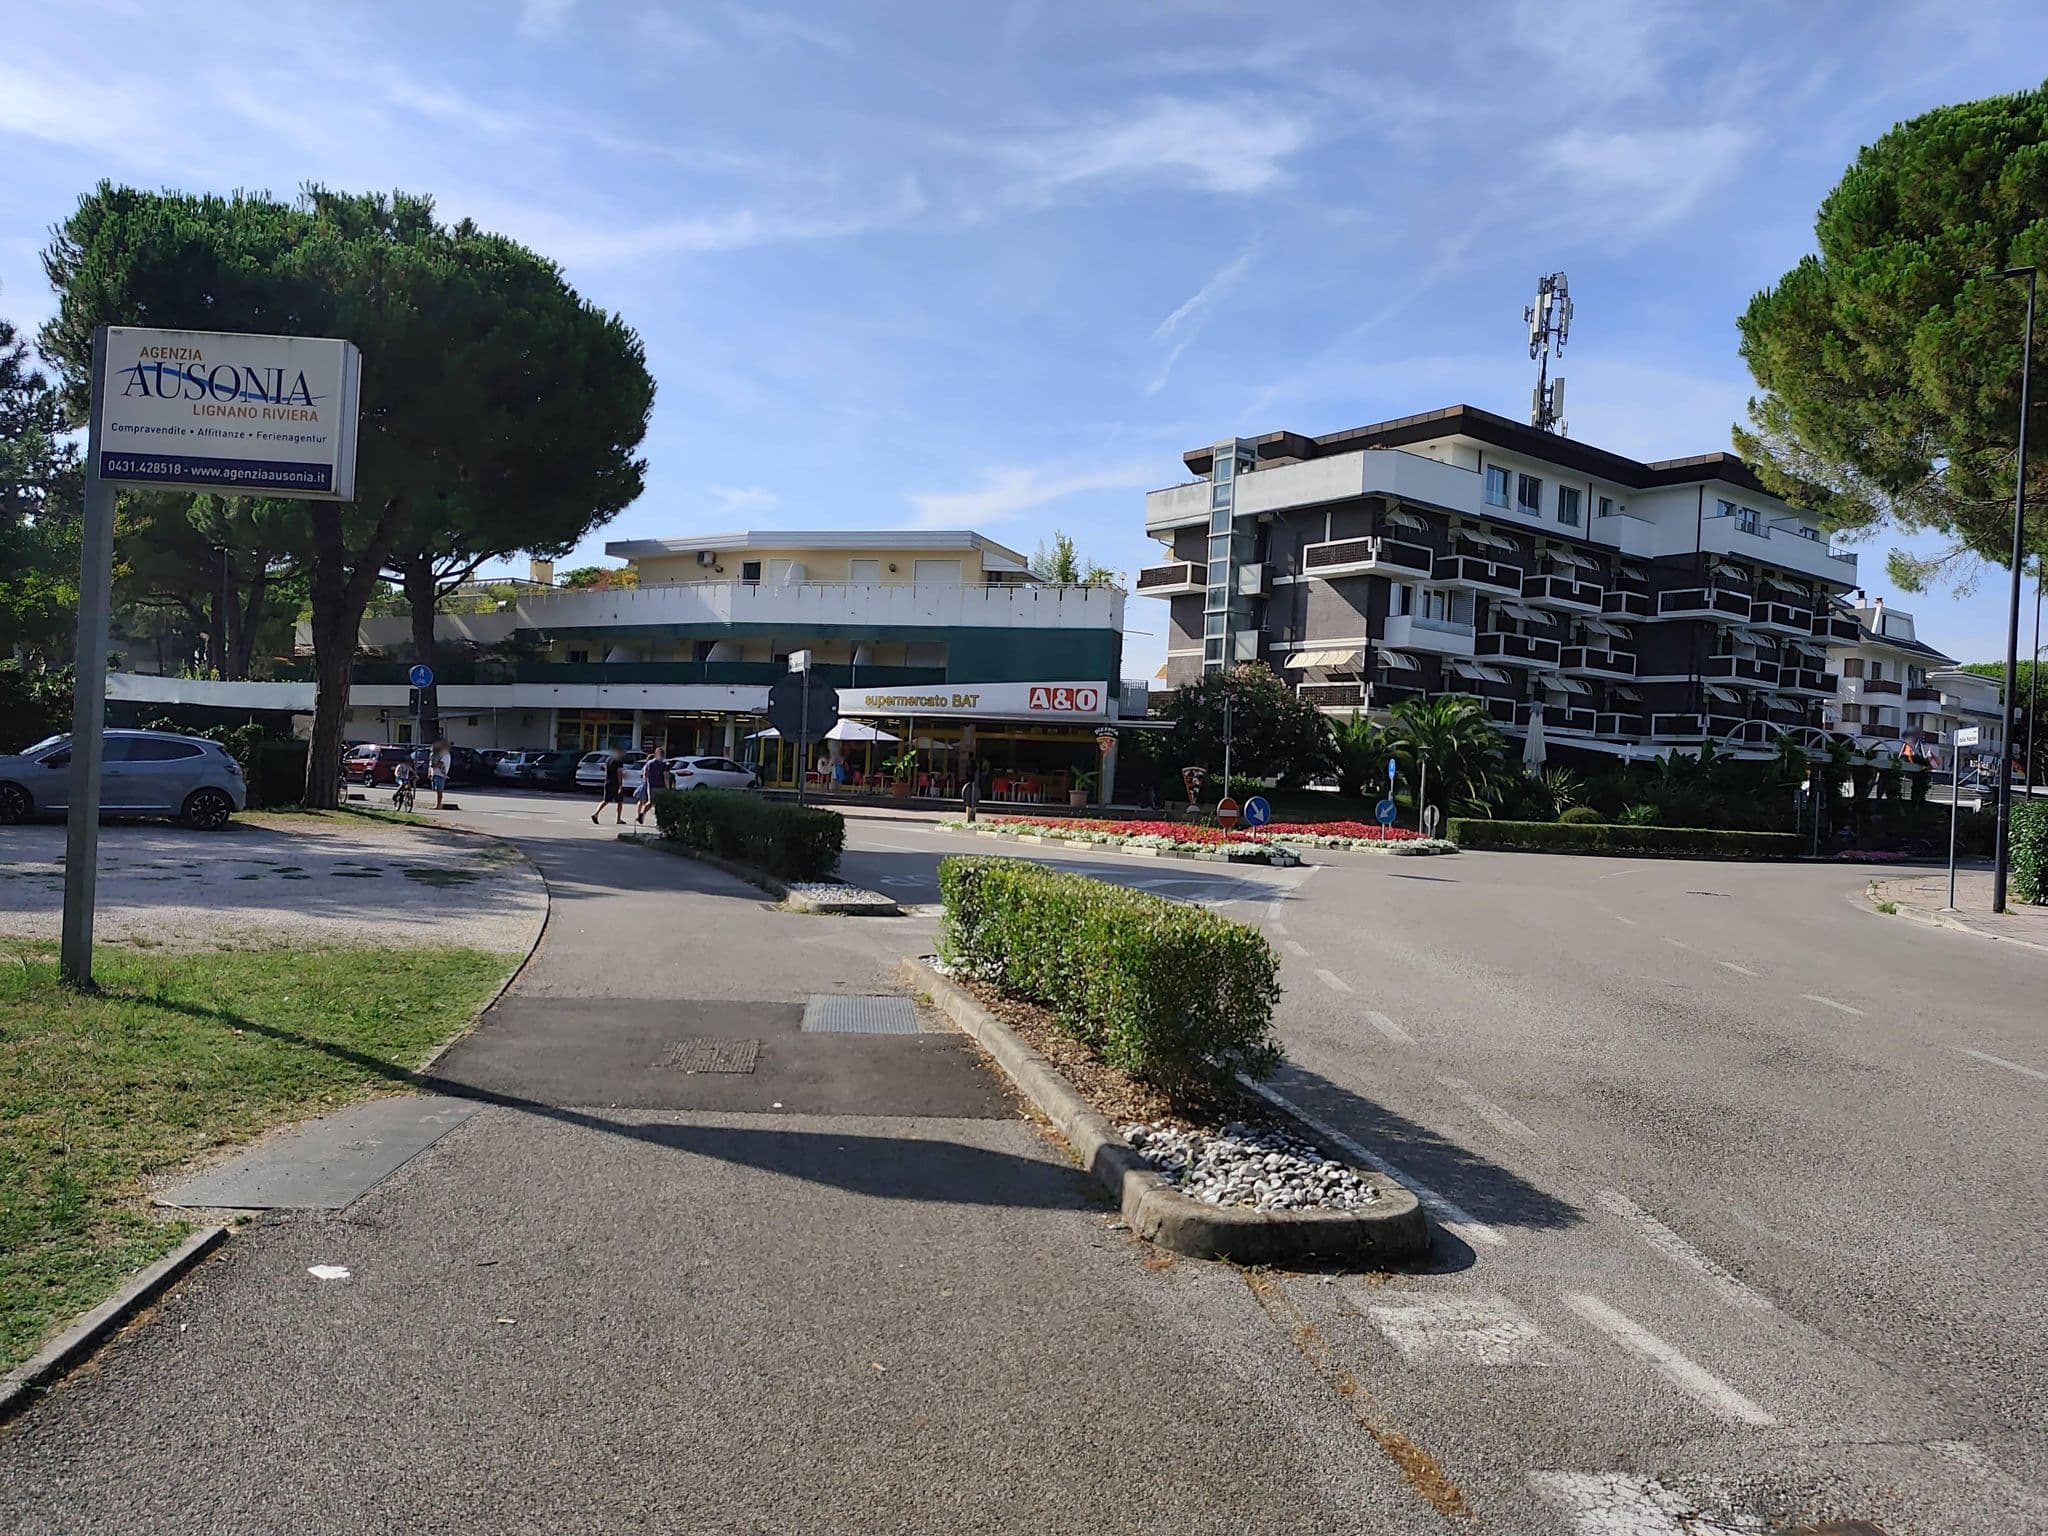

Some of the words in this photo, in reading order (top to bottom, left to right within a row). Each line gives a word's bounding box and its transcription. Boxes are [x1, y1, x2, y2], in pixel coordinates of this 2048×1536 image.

[140, 346, 202, 361] AGENZIA
[121, 360, 317, 407] AUSONIA
[193, 404, 258, 419] LIGNANO
[262, 407, 319, 422] RIVIERA
[111, 422, 187, 436] Compravendite
[197, 428, 245, 439] Affittanze
[256, 431, 327, 444] Ferienagentur
[108, 459, 182, 475] 0431.428518
[191, 466, 325, 484] www.agenziaausonia.it
[865, 694, 948, 709] supermercato
[951, 693, 980, 708] BAT
[1030, 687, 1098, 712] A&O
